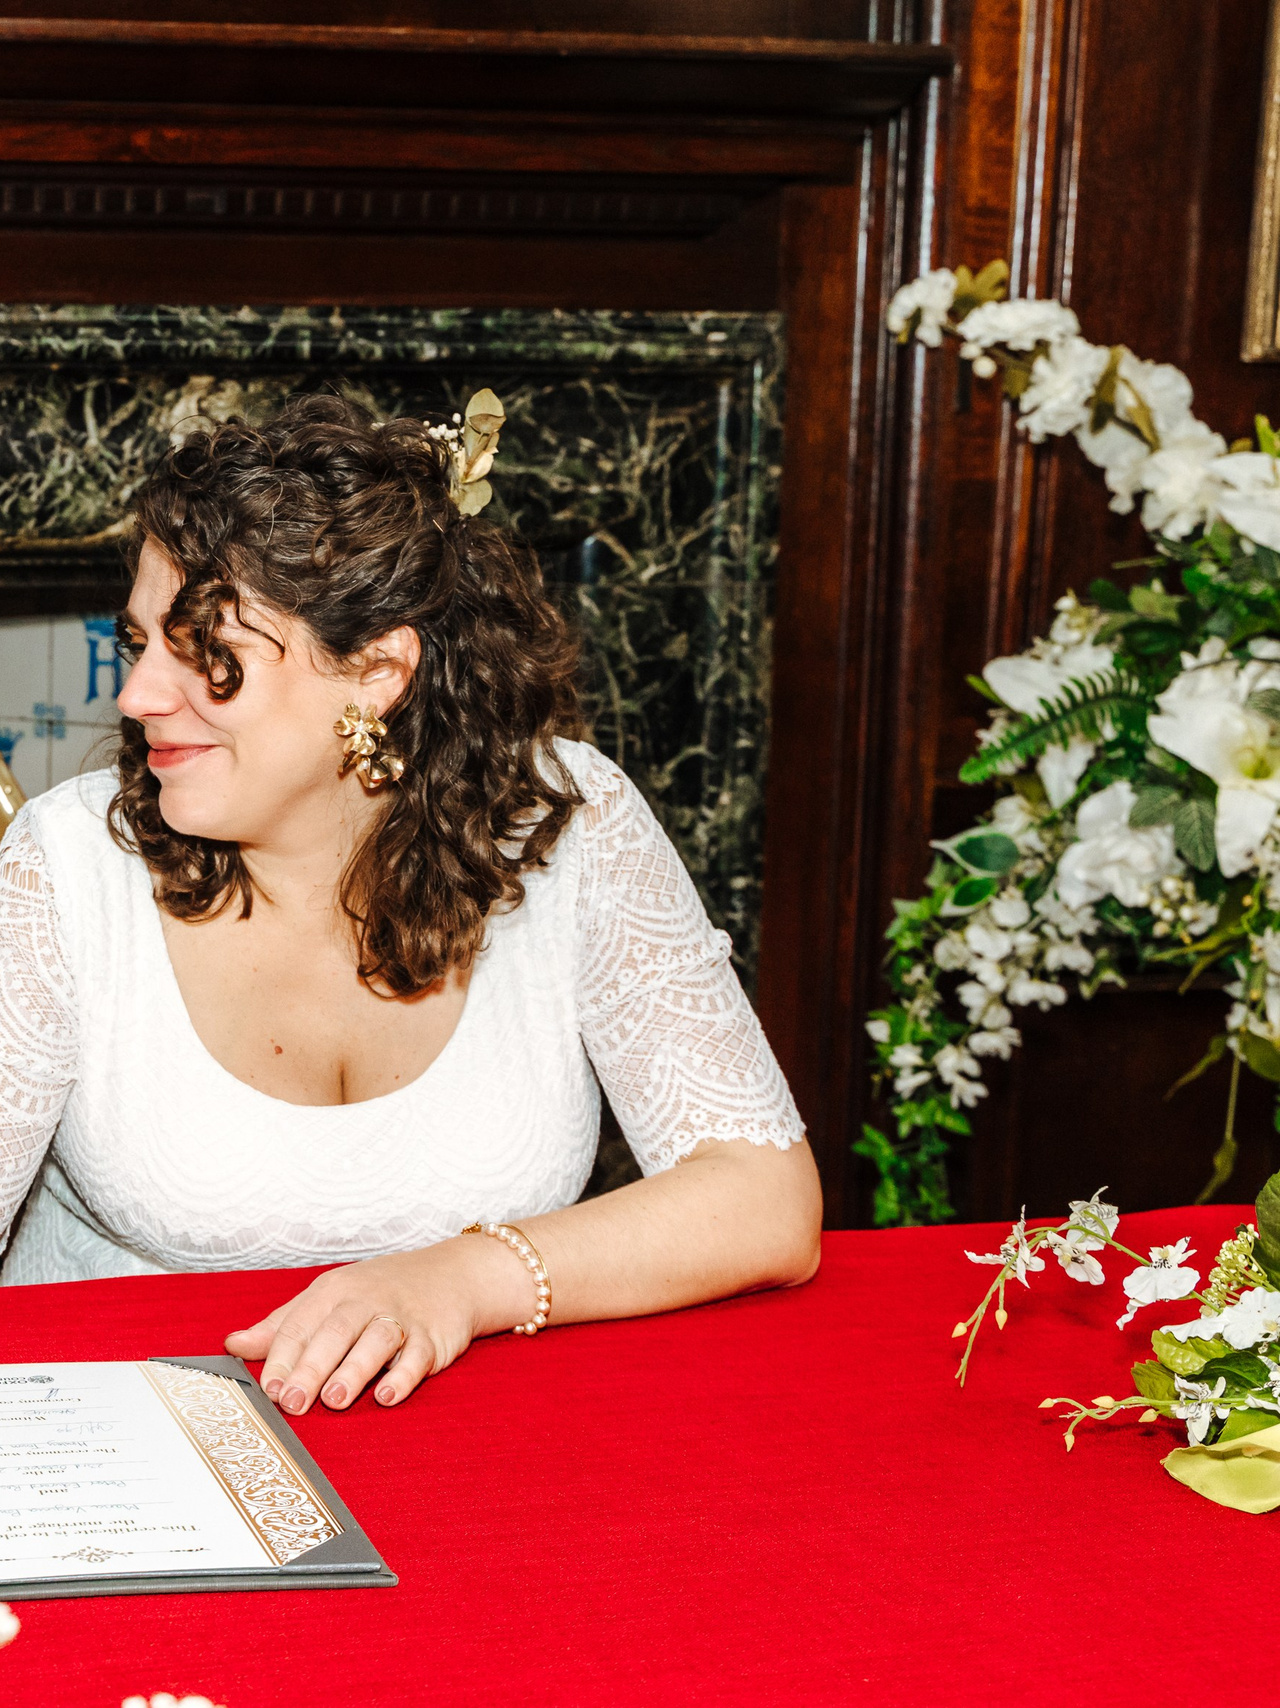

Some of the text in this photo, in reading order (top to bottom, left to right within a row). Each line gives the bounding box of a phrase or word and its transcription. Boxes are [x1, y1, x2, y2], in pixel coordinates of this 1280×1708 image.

[30, 1481, 81, 1489] Edward
[28, 1504, 87, 1514] Virginia
[28, 1521, 102, 1531] marriage
[73, 1526, 157, 1535] certificate
